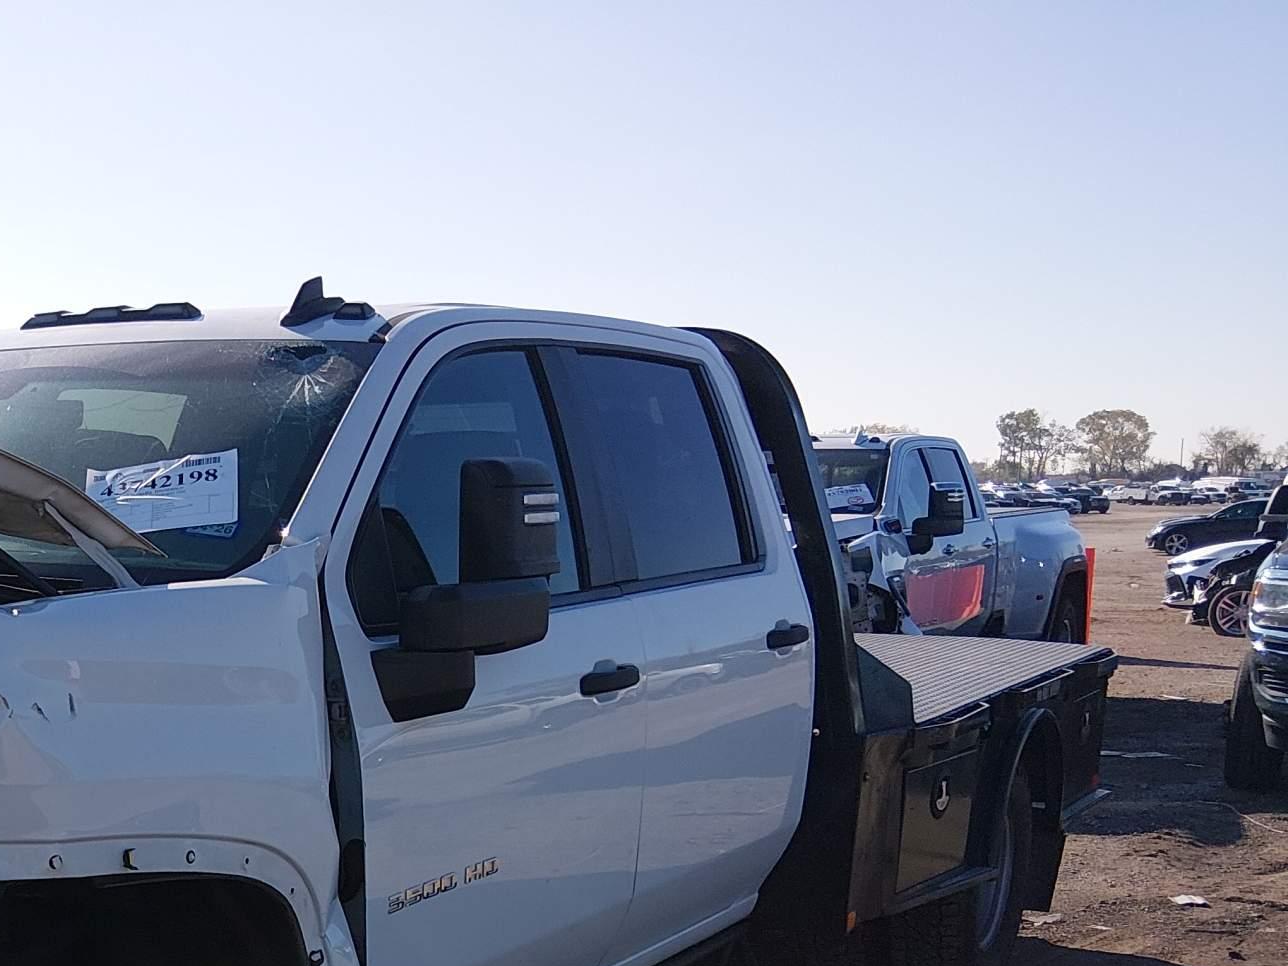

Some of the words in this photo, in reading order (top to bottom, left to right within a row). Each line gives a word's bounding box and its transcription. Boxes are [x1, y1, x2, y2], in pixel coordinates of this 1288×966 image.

[100, 468, 219, 497] 43742198
[387, 871, 458, 915] 3500
[463, 856, 501, 884] HD
